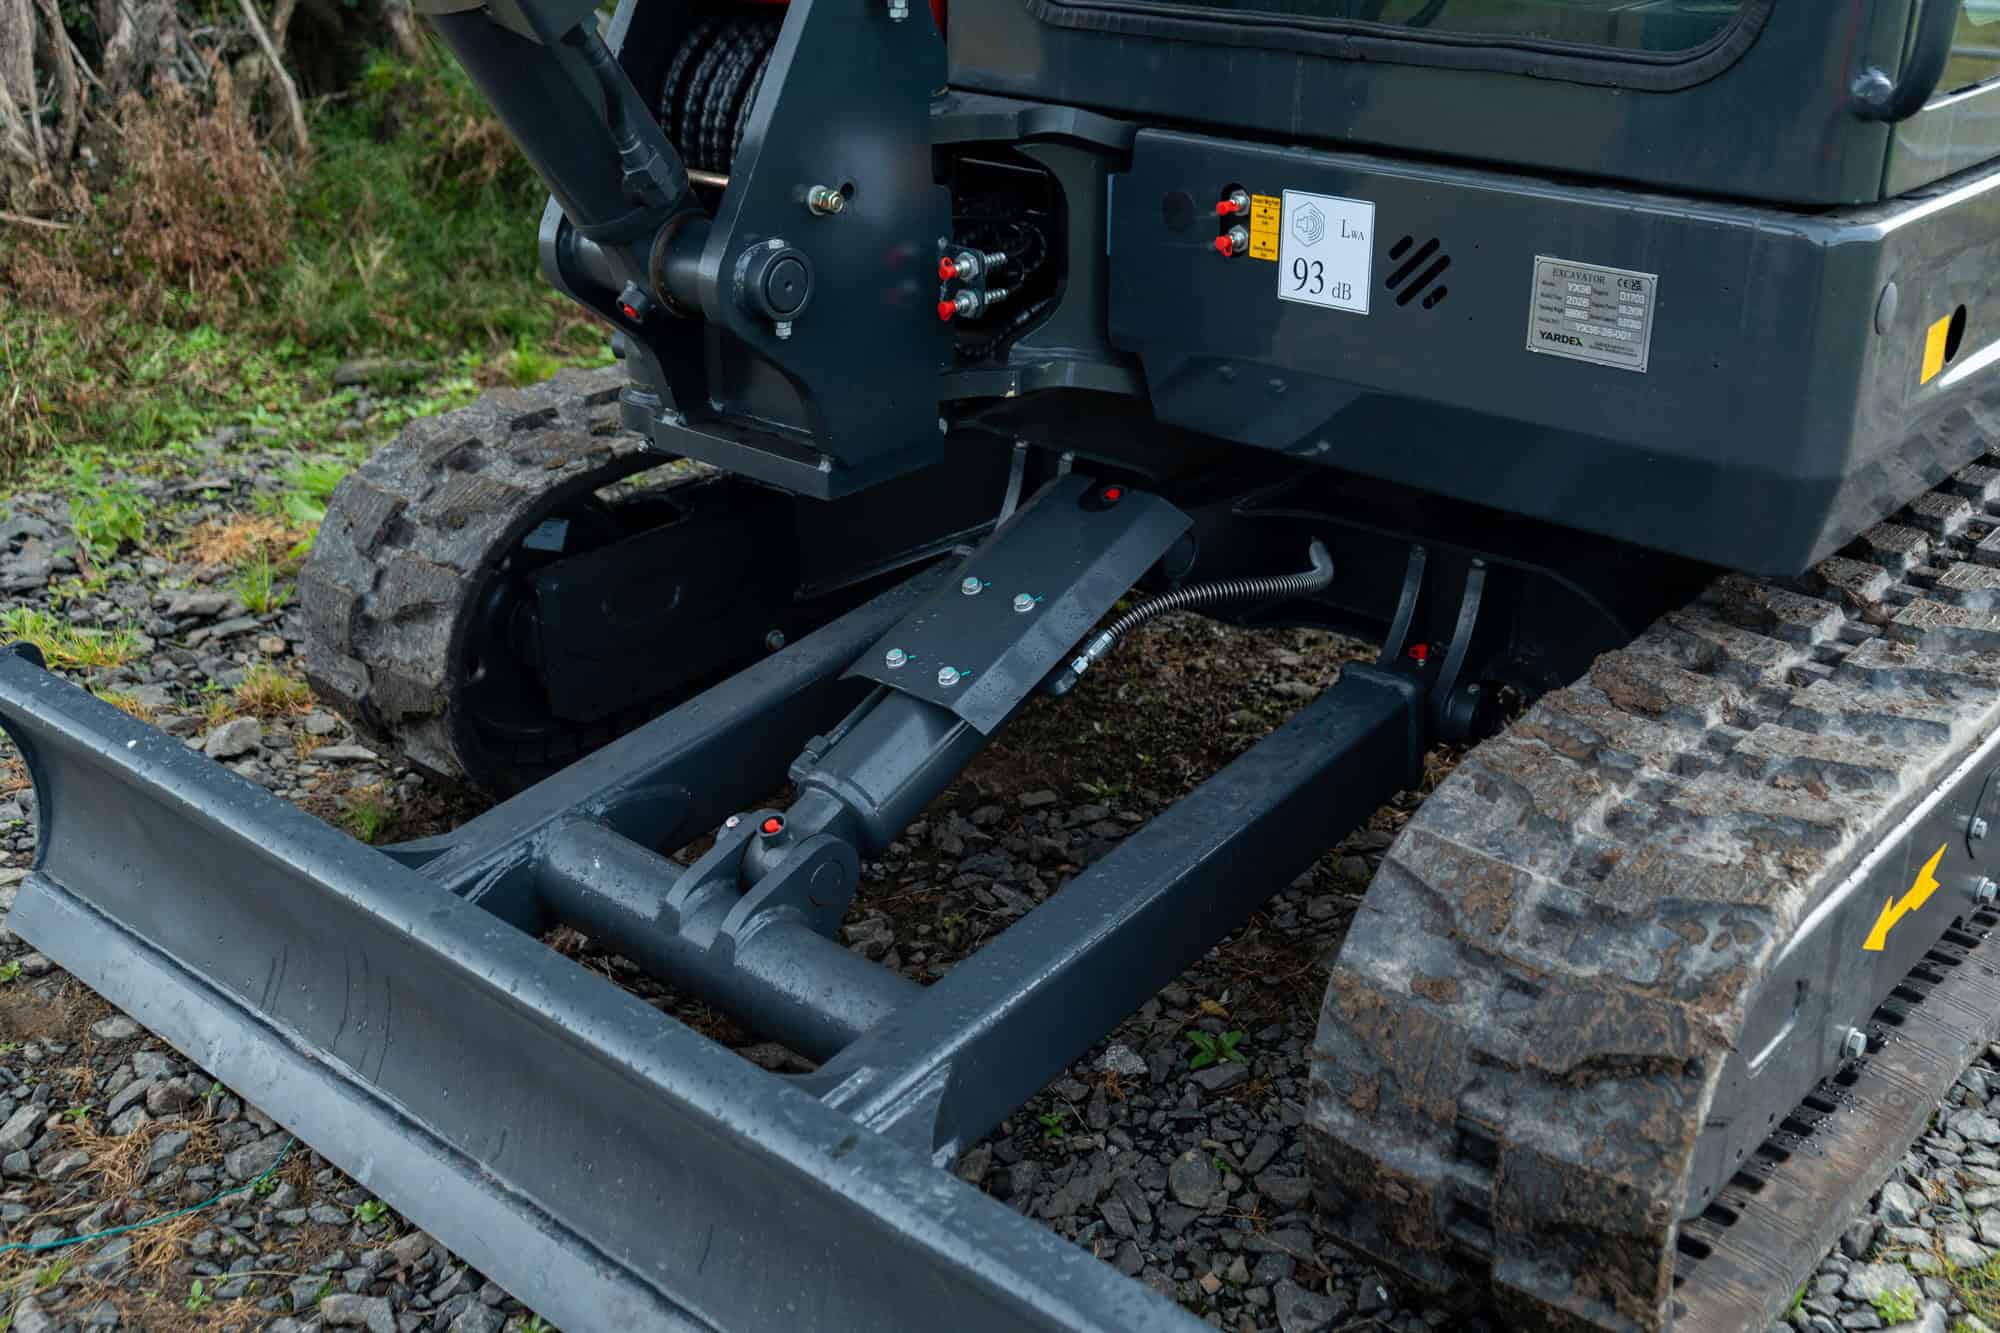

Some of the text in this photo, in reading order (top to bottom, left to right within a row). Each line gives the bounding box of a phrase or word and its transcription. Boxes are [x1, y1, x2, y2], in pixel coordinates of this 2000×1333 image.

[1292, 257, 1351, 300] 93 dB
[1552, 268, 1605, 284] EXCAVATOR
[1539, 330, 1584, 346] YARDEX
